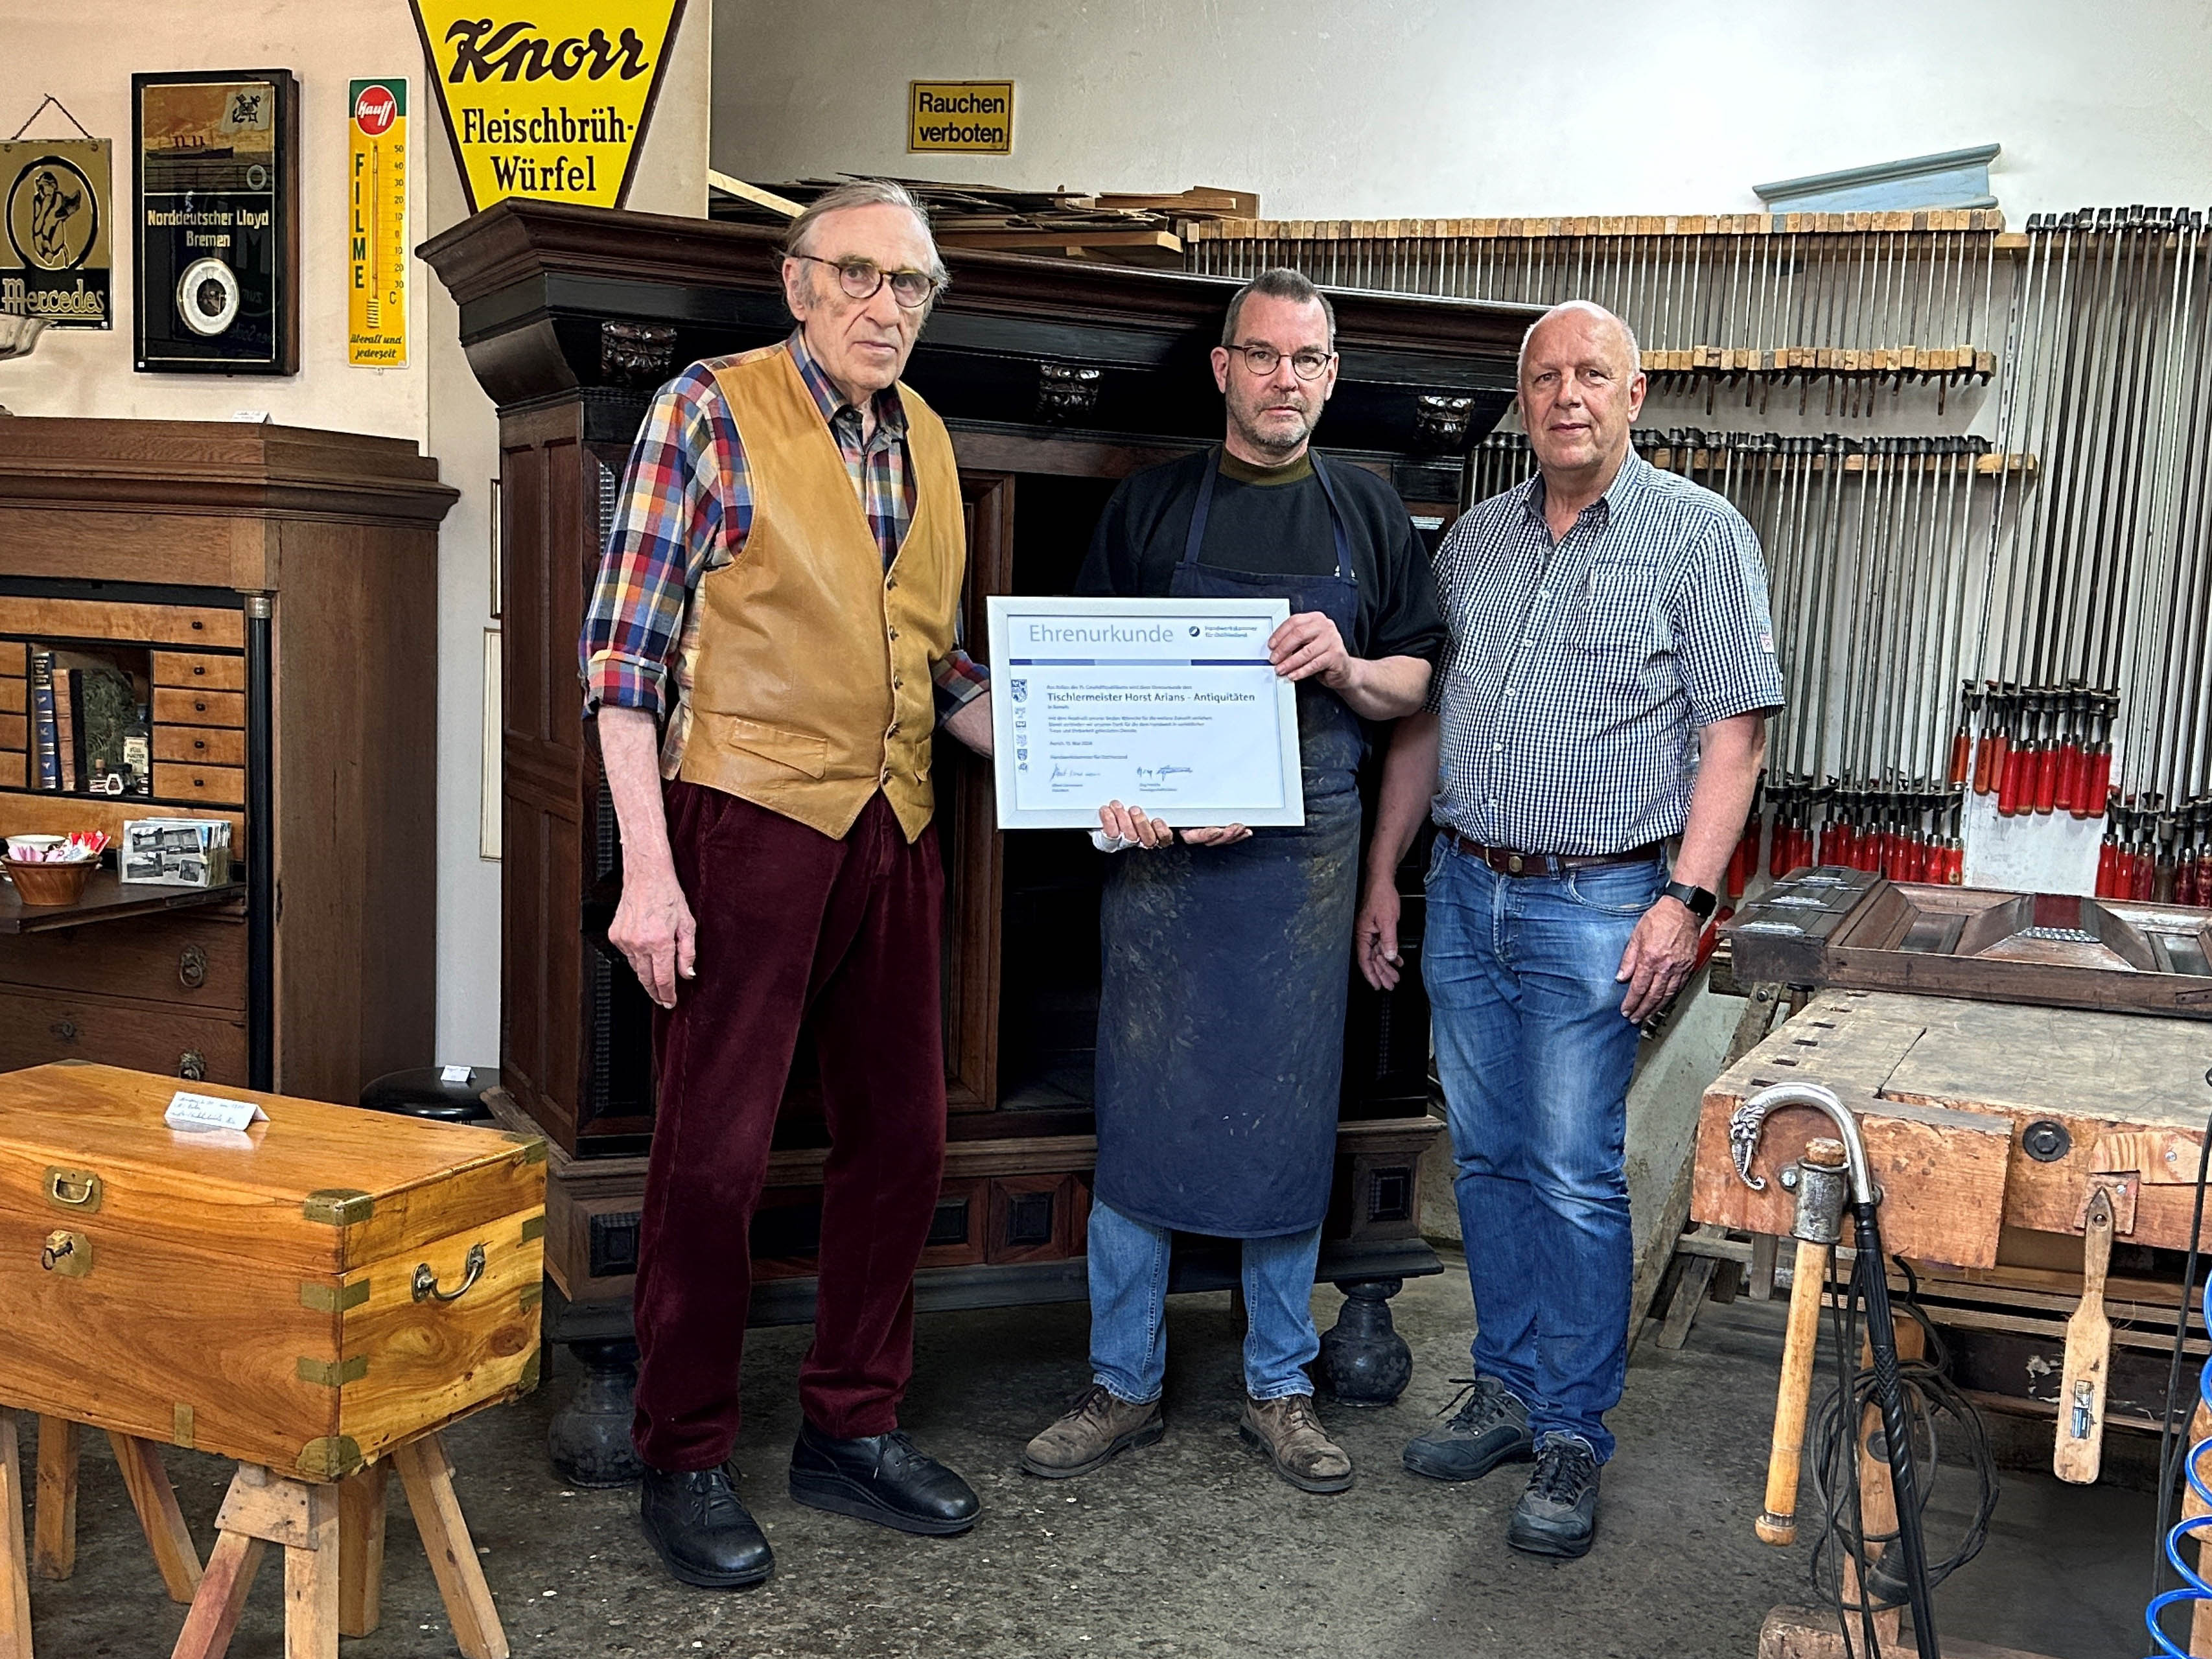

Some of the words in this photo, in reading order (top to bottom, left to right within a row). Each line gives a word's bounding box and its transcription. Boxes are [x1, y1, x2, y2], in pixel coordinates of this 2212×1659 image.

[445, 19, 649, 83] Knorr
[358, 100, 393, 126] Hauff
[919, 92, 1005, 113] Rauchen
[463, 106, 633, 143] Fleischbrüh-
[919, 122, 1003, 143] verboten
[491, 156, 596, 191] Würfel
[147, 209, 233, 226] Norddeutscher
[237, 209, 269, 229] Lloyd
[353, 153, 366, 288] FILME
[186, 231, 230, 247] Bremen
[2, 278, 104, 316] Mercedes
[383, 336, 402, 344] und
[1029, 624, 1174, 643] Ehrenurkunde
[1047, 692, 1122, 701] Tischlermeister
[1125, 693, 1152, 701] Horst
[1154, 692, 1185, 701] Arians
[1194, 692, 1255, 703] Antiquitäten
